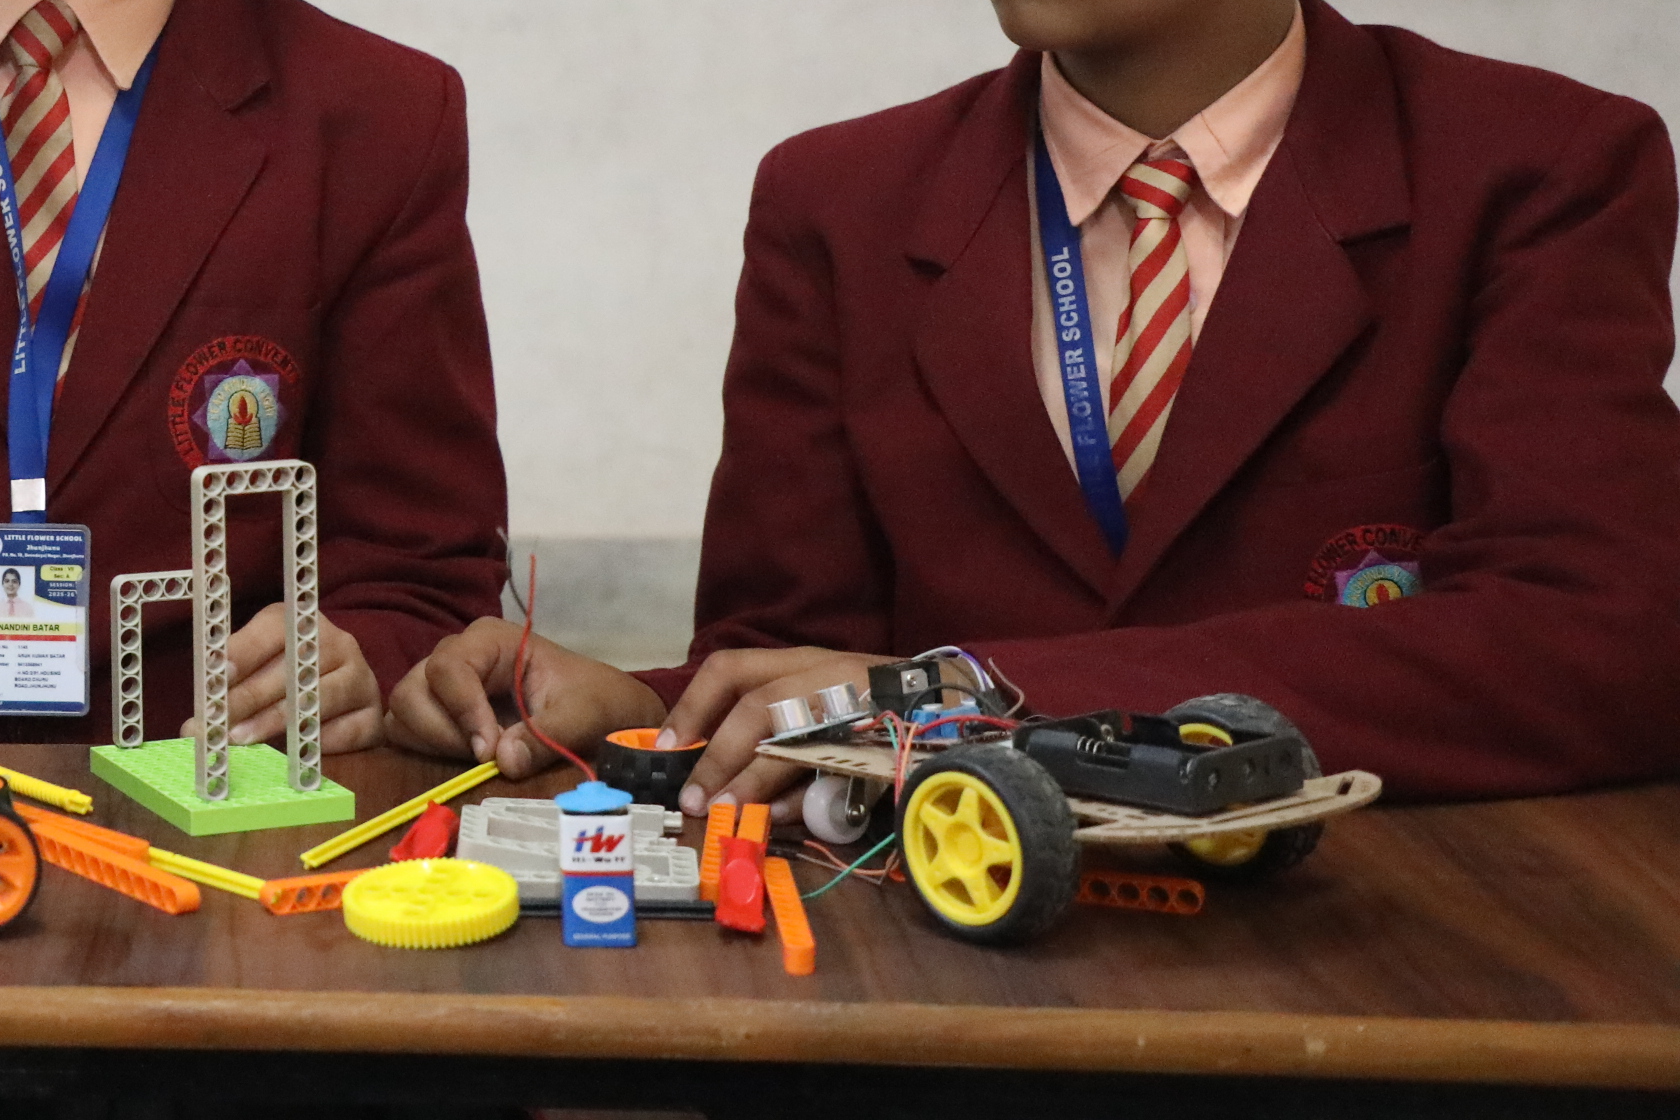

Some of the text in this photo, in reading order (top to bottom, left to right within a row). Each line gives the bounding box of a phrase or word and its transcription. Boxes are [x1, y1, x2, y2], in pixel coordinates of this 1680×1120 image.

[1051, 246, 1081, 342] SCHOOL
[174, 339, 229, 395] FLOWER
[1065, 346, 1097, 446] FLOWER
[27, 534, 54, 542] FLOWER
[32, 624, 60, 632] BATAR
